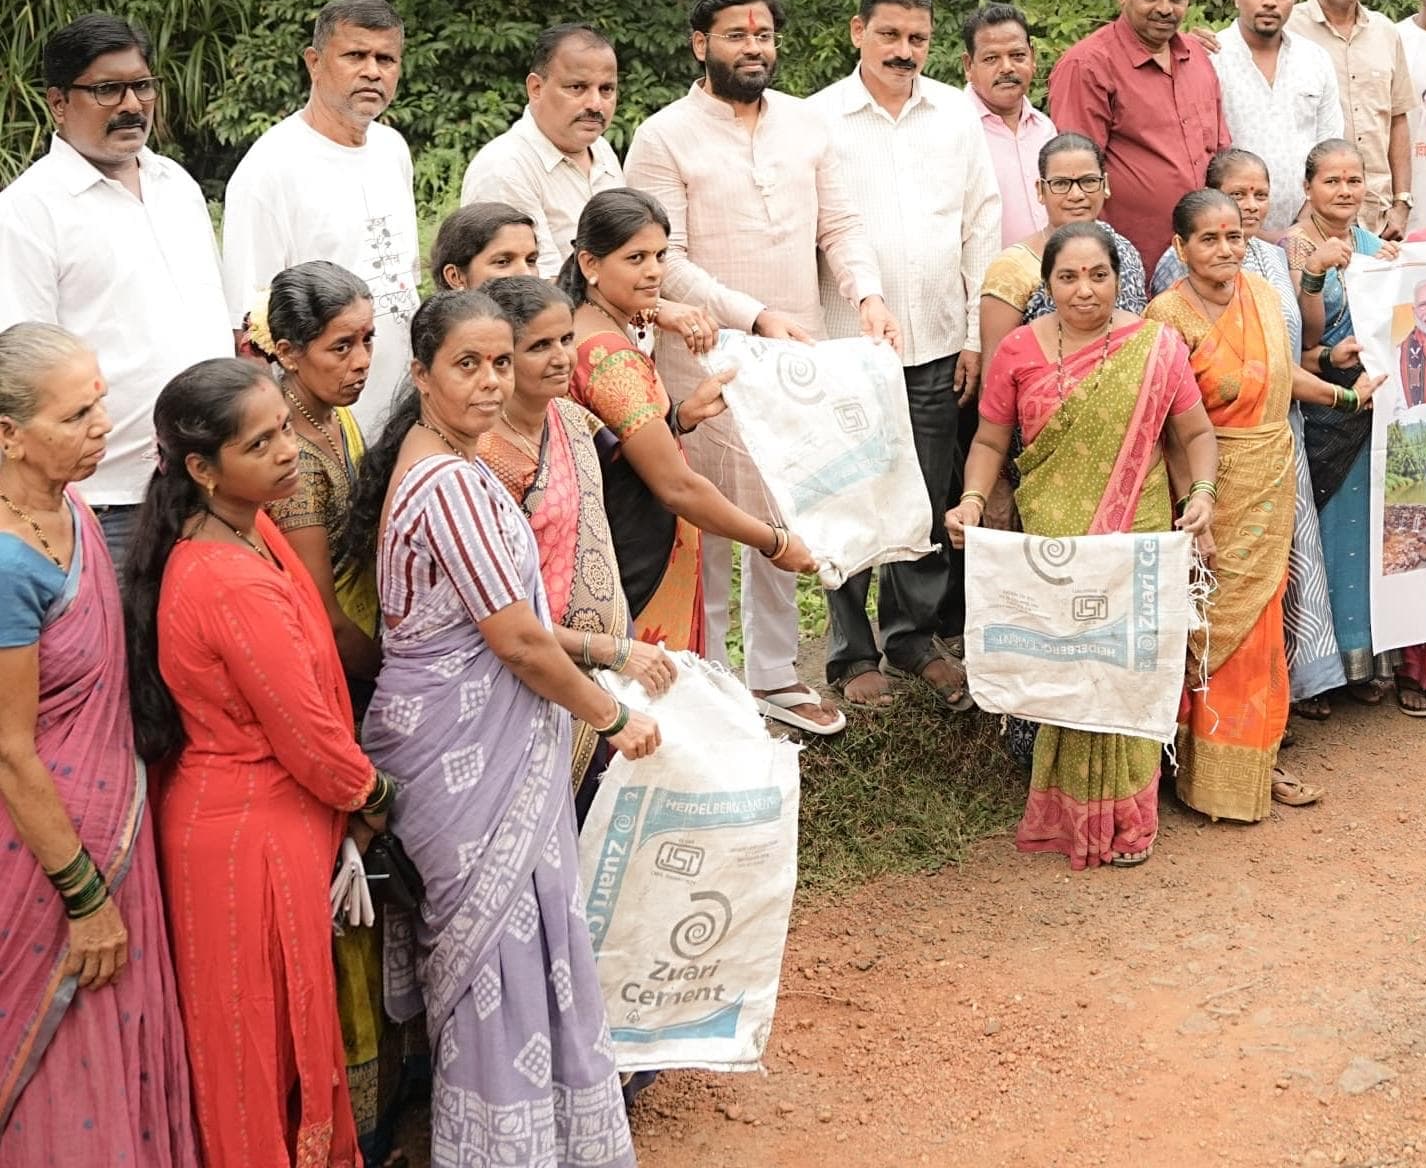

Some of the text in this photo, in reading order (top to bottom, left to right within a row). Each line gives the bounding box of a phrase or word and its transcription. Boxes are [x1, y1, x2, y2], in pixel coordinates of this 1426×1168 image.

[1138, 573, 1156, 630] Zuari
[591, 839, 628, 908] Zuari
[648, 959, 721, 983] Zuari
[621, 982, 726, 1007] Cement
